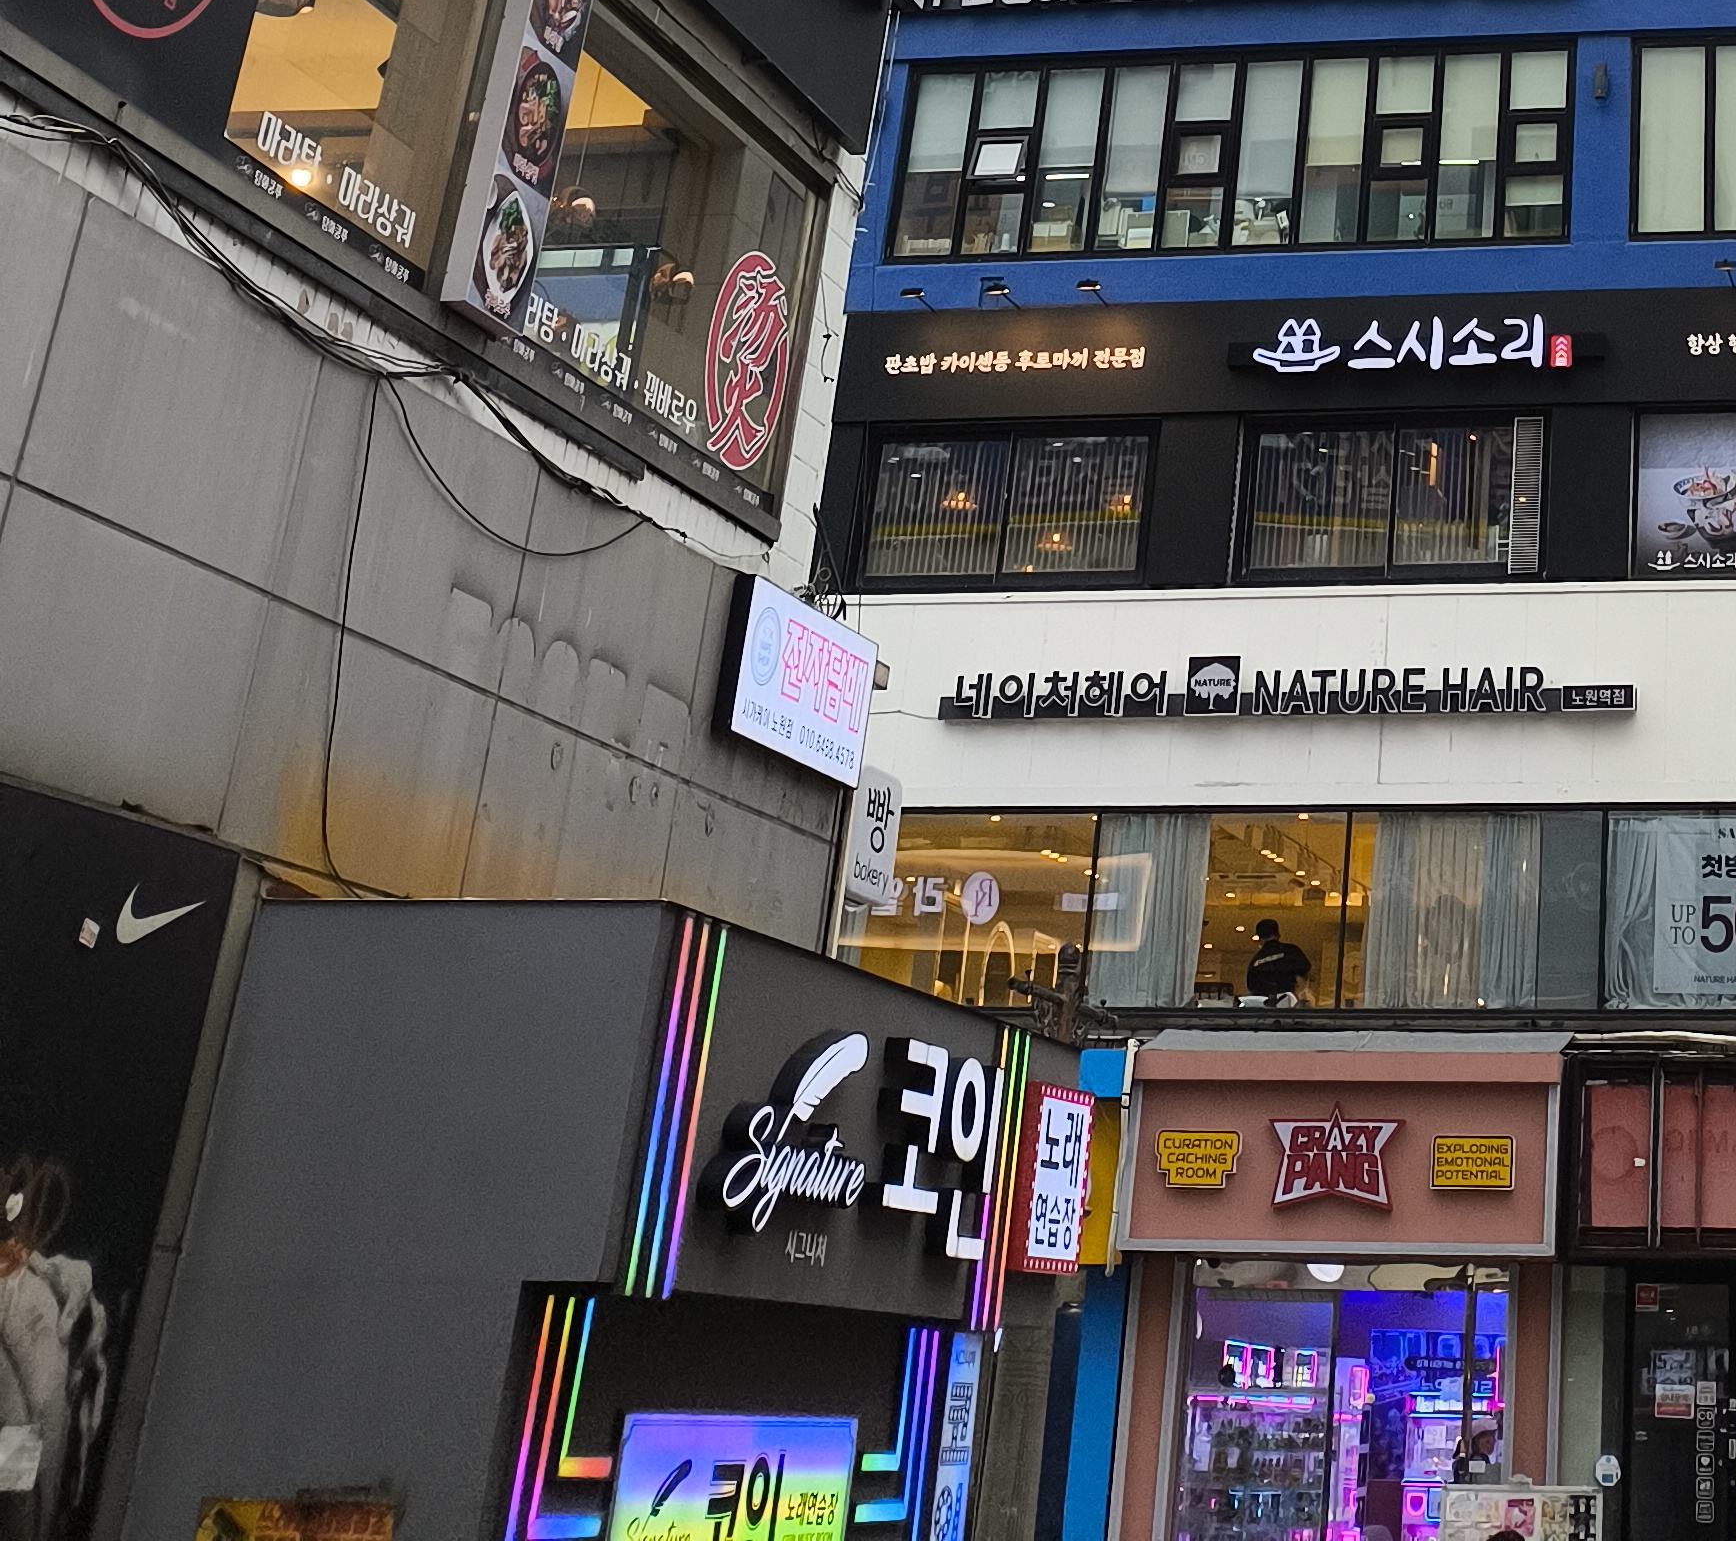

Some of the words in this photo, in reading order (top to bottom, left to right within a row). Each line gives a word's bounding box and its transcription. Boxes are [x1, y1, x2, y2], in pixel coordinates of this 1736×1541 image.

[1347, 313, 1544, 370] 스시소리
[1686, 332, 1724, 355] 항상
[884, 354, 937, 376] 판초밥
[1092, 346, 1147, 370] 전문점
[780, 618, 870, 734] 전자담배
[1193, 678, 1233, 689] NATURE
[1251, 667, 1428, 715] NATURE
[1438, 665, 1548, 712] HAIR
[954, 670, 1169, 717] 네이처헤어
[1570, 687, 1626, 708] 노원역점
[867, 786, 895, 854] 빵
[854, 852, 890, 892] bakery
[1670, 903, 1697, 924] UP
[1670, 925, 1697, 946] TO
[1040, 1107, 1085, 1190] 노래
[1162, 1138, 1234, 1151] CURATION
[1288, 1117, 1386, 1154] CRAZY
[1436, 1143, 1510, 1156] EXPLODING
[722, 1105, 867, 1233] Signature
[1166, 1152, 1228, 1165] CACHING
[1174, 1166, 1218, 1180] ROOM
[1281, 1153, 1380, 1196] PANG
[1436, 1156, 1511, 1168] EMOTIONAL
[1435, 1169, 1507, 1182] POTENTIAL
[1034, 1192, 1077, 1251] 연습장
[784, 1491, 840, 1527] 노래연습장
